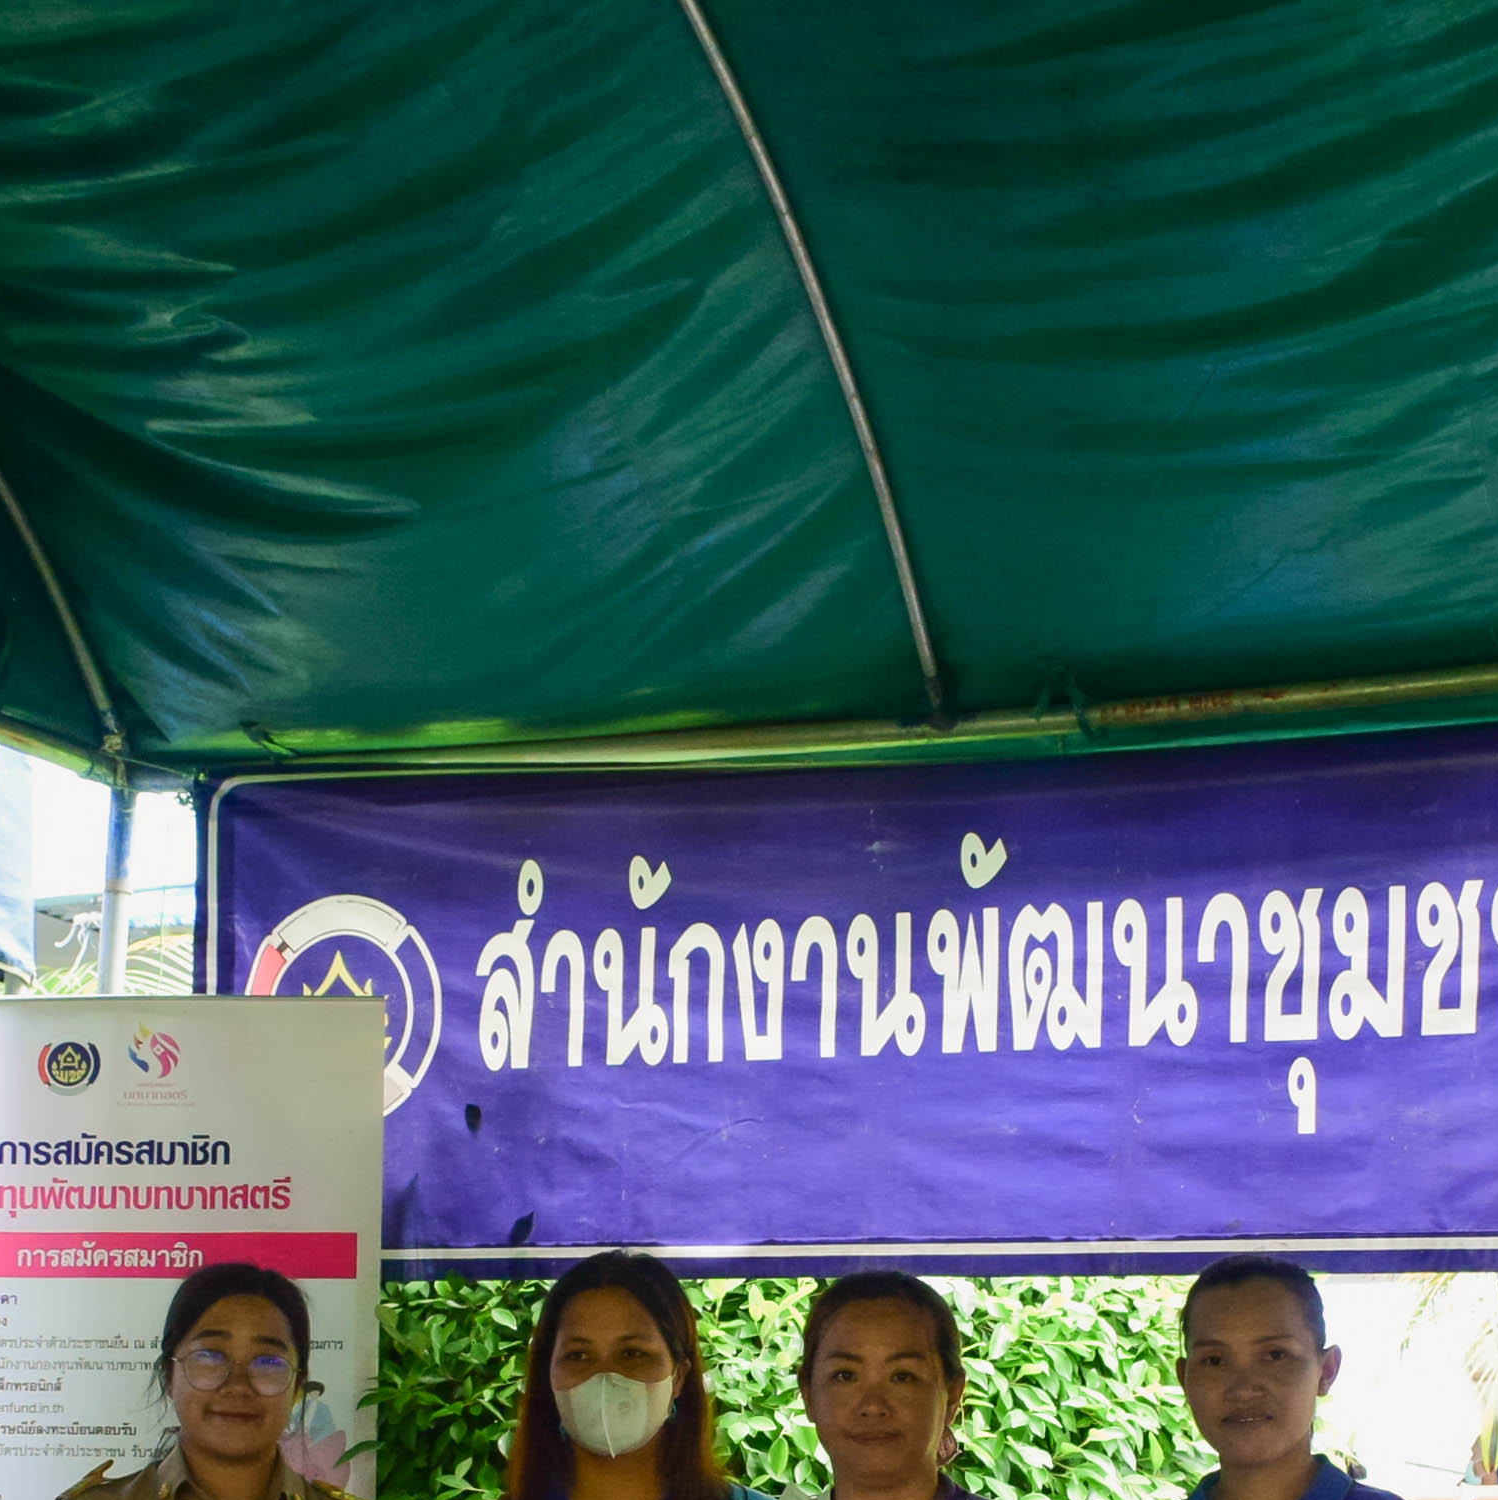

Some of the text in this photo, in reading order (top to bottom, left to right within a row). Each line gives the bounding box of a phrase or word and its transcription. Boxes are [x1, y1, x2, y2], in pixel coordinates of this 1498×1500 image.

[17, 1241, 204, 1268] การสมัครสมาชิก
